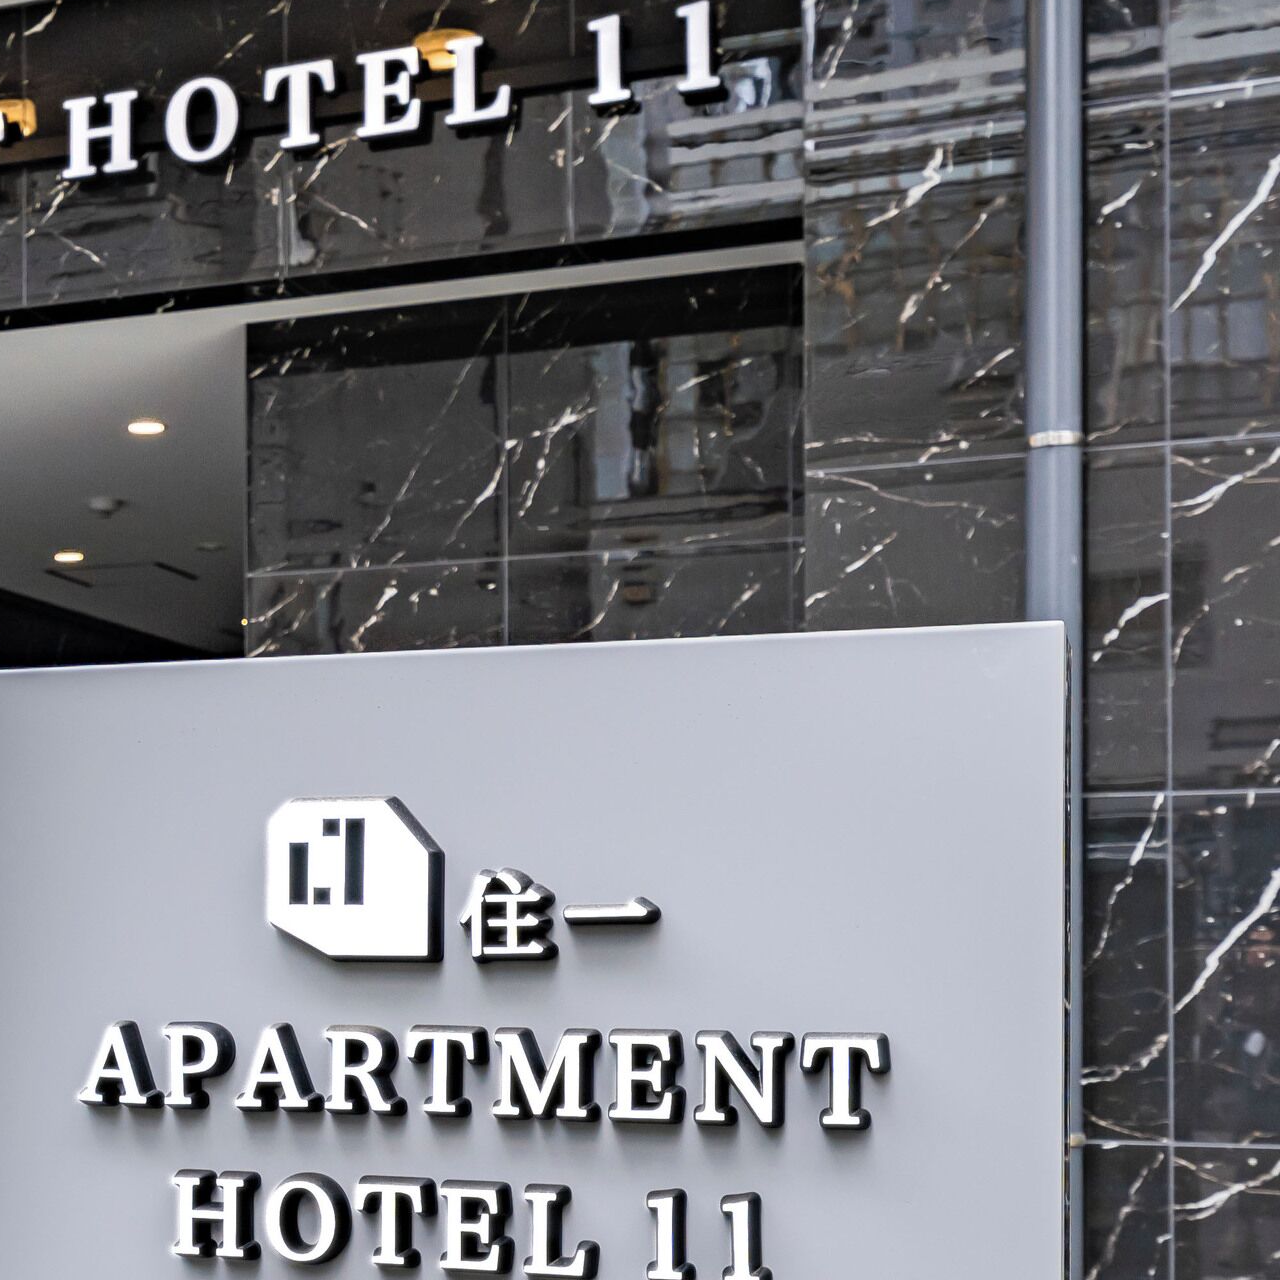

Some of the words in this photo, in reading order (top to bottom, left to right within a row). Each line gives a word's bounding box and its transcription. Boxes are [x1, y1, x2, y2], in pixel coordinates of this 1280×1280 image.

[61, 35, 513, 181] HOTEL
[586, 0, 722, 106] 11
[77, 1020, 892, 1130] APARTMENT
[170, 1168, 599, 1280] HOTEL
